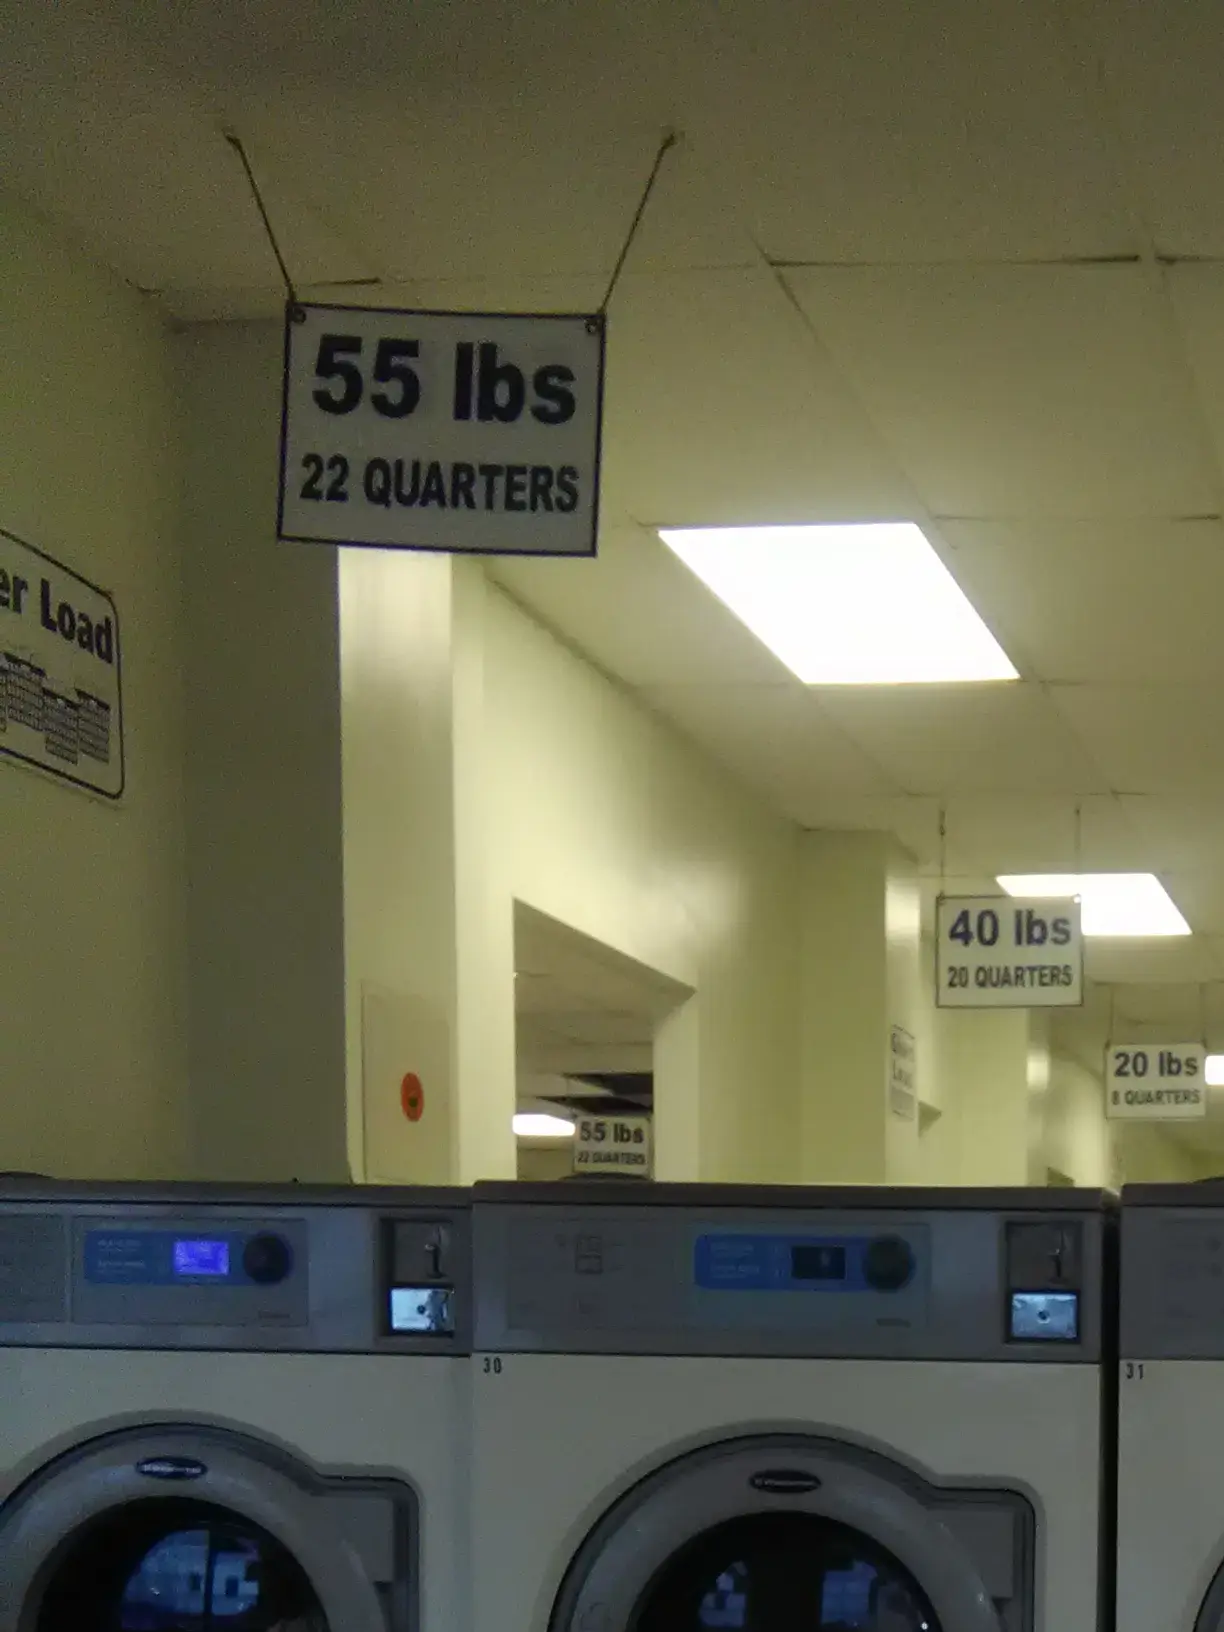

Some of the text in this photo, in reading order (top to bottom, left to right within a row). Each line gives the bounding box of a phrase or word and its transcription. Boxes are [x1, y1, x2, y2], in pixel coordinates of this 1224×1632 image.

[312, 333, 576, 425] 55 lbs
[300, 453, 580, 513] 22 QUARTERS
[40, 577, 113, 664] Load
[949, 908, 1071, 947] 40 lbs
[948, 964, 1073, 990] 20 QUARTERS
[1114, 1050, 1198, 1078] 20 lbs
[1124, 1088, 1200, 1106] QUARTERS
[614, 1123, 644, 1144] lbs
[484, 1356, 502, 1375] 30
[1126, 1363, 1144, 1380] 31
